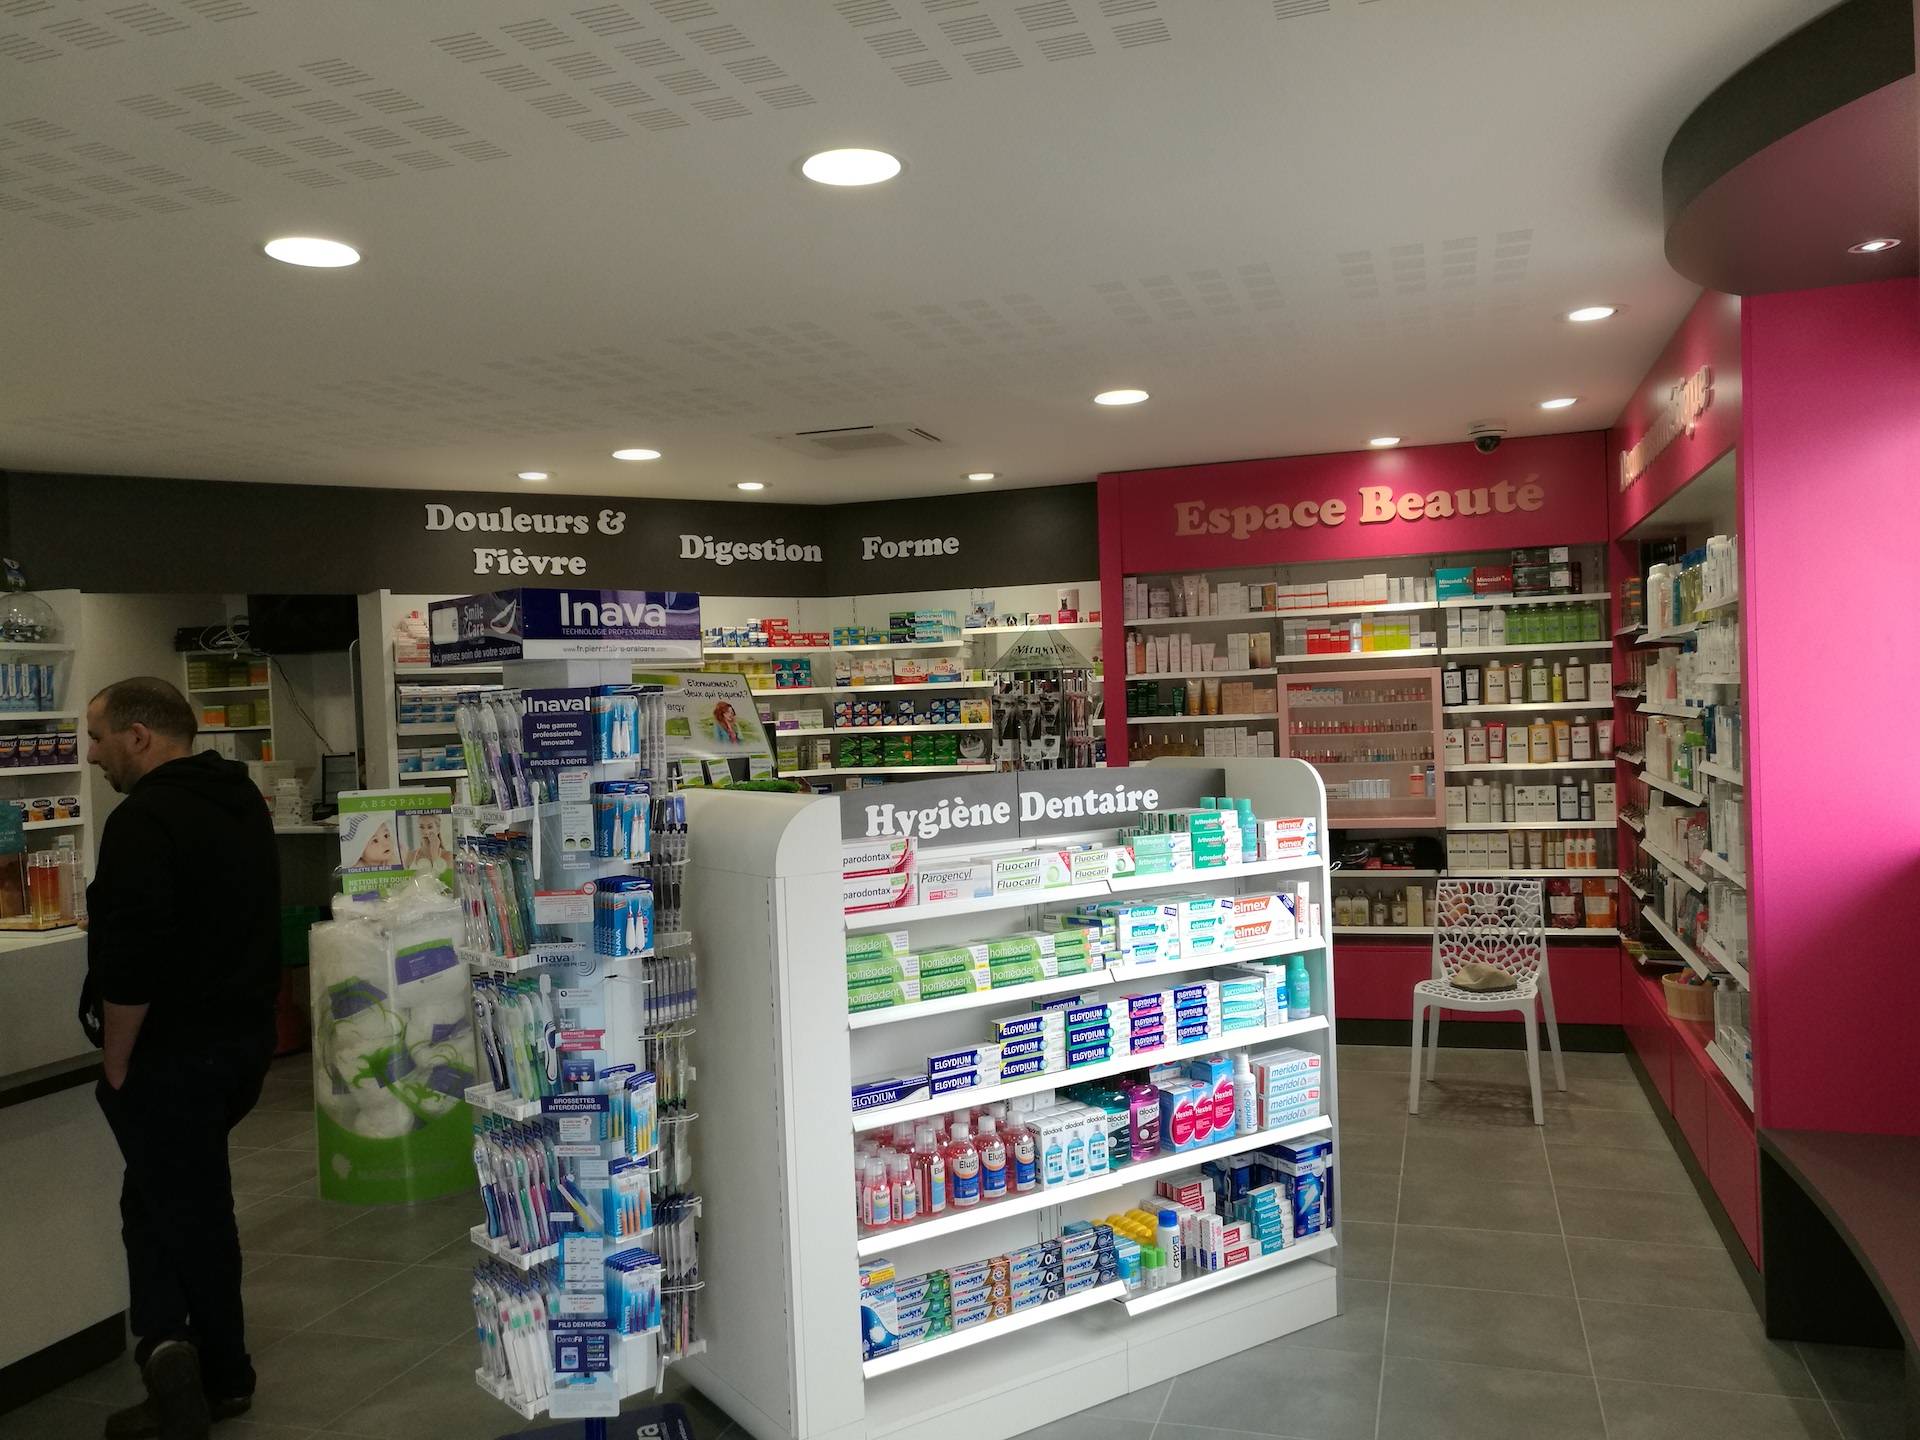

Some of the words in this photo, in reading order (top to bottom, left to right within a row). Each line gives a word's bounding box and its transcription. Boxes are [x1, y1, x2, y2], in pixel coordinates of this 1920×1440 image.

[1174, 498, 1347, 540] Espace
[1358, 472, 1546, 525] Beauté
[424, 503, 590, 536] Douleurs
[596, 509, 627, 536] &
[679, 534, 824, 566] Digestion
[861, 536, 960, 562] Forme
[473, 547, 588, 577] Fièvre
[464, 604, 484, 621] Smile
[560, 592, 667, 627] Inava
[468, 622, 485, 637] Care
[562, 628, 608, 636] TECHNOLOGIE
[608, 628, 667, 636] PROFESSIONNELLE
[442, 653, 460, 664] prenez
[461, 649, 474, 660] soin
[500, 644, 520, 656] sourire
[533, 730, 582, 740] professionnelle
[360, 798, 433, 809] ABSOPADS
[865, 798, 1010, 840] Hygiène
[1019, 785, 1159, 824] Dentaire
[1277, 820, 1302, 830] elmex
[1278, 838, 1304, 849] elmex
[843, 853, 890, 867] parodontax
[1074, 852, 1109, 864] Fluocaril
[996, 859, 1040, 872] Fluocaril
[921, 869, 973, 885] Parogencyl
[1075, 868, 1110, 878] Fluocaril
[997, 876, 1041, 889] Fluocaril
[844, 887, 890, 900] parodontax
[1234, 901, 1267, 914] elmex
[1235, 925, 1268, 938] elmex
[847, 938, 888, 952] méodent
[990, 942, 1037, 958] homéodent
[537, 954, 570, 963] Inava
[921, 952, 970, 968] homéodent
[992, 964, 1040, 980] homéodent
[922, 976, 972, 992] homéodent
[1069, 1009, 1103, 1023] ELGYDIUM
[1003, 1022, 1038, 1036] ELGYDIUM
[1072, 1029, 1105, 1043] ELGYDIUM
[1003, 1041, 1038, 1056] ELGYDIUM
[1072, 1048, 1105, 1062] ELGYDIUM
[934, 1055, 972, 1070] ELGYDIUM
[1003, 1060, 1038, 1076] ELGYDIUM
[1271, 1064, 1300, 1077] meridol
[934, 1076, 972, 1092] ELGYDIUM
[1271, 1080, 1299, 1092] meridol
[852, 1091, 897, 1108] ELGYDIUM
[1215, 1090, 1232, 1100] Hextril
[1271, 1096, 1299, 1108] meridol
[1139, 1106, 1160, 1115] alodont
[1176, 1110, 1193, 1120] Hextril
[1196, 1104, 1212, 1115] Hextril
[1087, 1115, 1106, 1124] alodont
[1107, 1113, 1130, 1123] alodont
[1270, 1112, 1299, 1125] meridol
[1043, 1128, 1063, 1136] alodont
[1065, 1121, 1084, 1130] alodont
[1066, 1241, 1091, 1255] Fixodent
[1013, 1258, 1038, 1272] Fixodent
[1045, 1254, 1057, 1264] 0%
[1066, 1259, 1092, 1273] Fixodent
[955, 1274, 983, 1288] Fixodent
[1014, 1276, 1040, 1290] Fixodent
[1046, 1272, 1058, 1283] 0%
[1067, 1277, 1092, 1291] Fixodent
[899, 1290, 922, 1302] xodent
[956, 1292, 984, 1307] Fixodent
[1015, 1294, 1040, 1308] Fixodent
[1047, 1290, 1059, 1300] 0%
[898, 1309, 922, 1321] xodent
[957, 1310, 984, 1326] Fixodent
[898, 1327, 924, 1340] xodent
